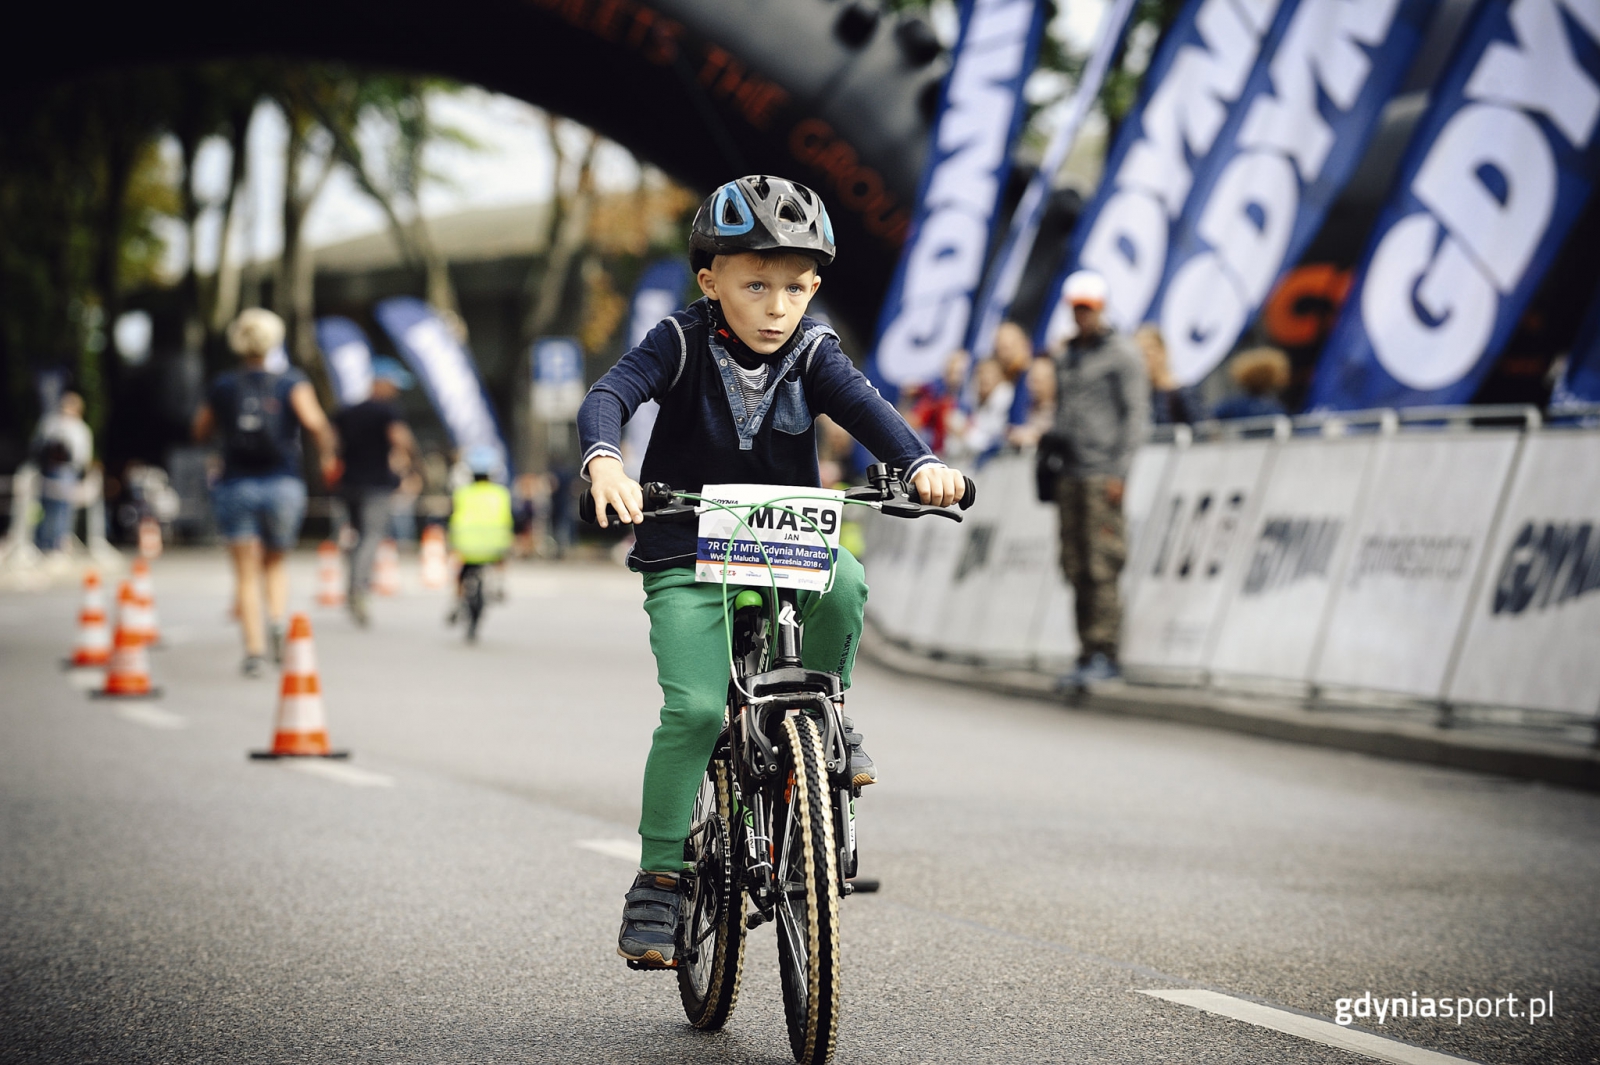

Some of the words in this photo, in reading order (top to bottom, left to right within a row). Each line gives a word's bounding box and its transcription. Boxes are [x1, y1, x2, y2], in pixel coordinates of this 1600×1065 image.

[748, 503, 837, 535] MA59
[784, 533, 800, 541] JAN
[708, 541, 720, 550] 7R
[740, 544, 760, 553] MTB
[763, 545, 793, 556] Gdynia
[710, 552, 733, 562] Wyścg
[733, 554, 760, 563] Malucha
[774, 558, 802, 566] września
[803, 560, 818, 568] 2018
